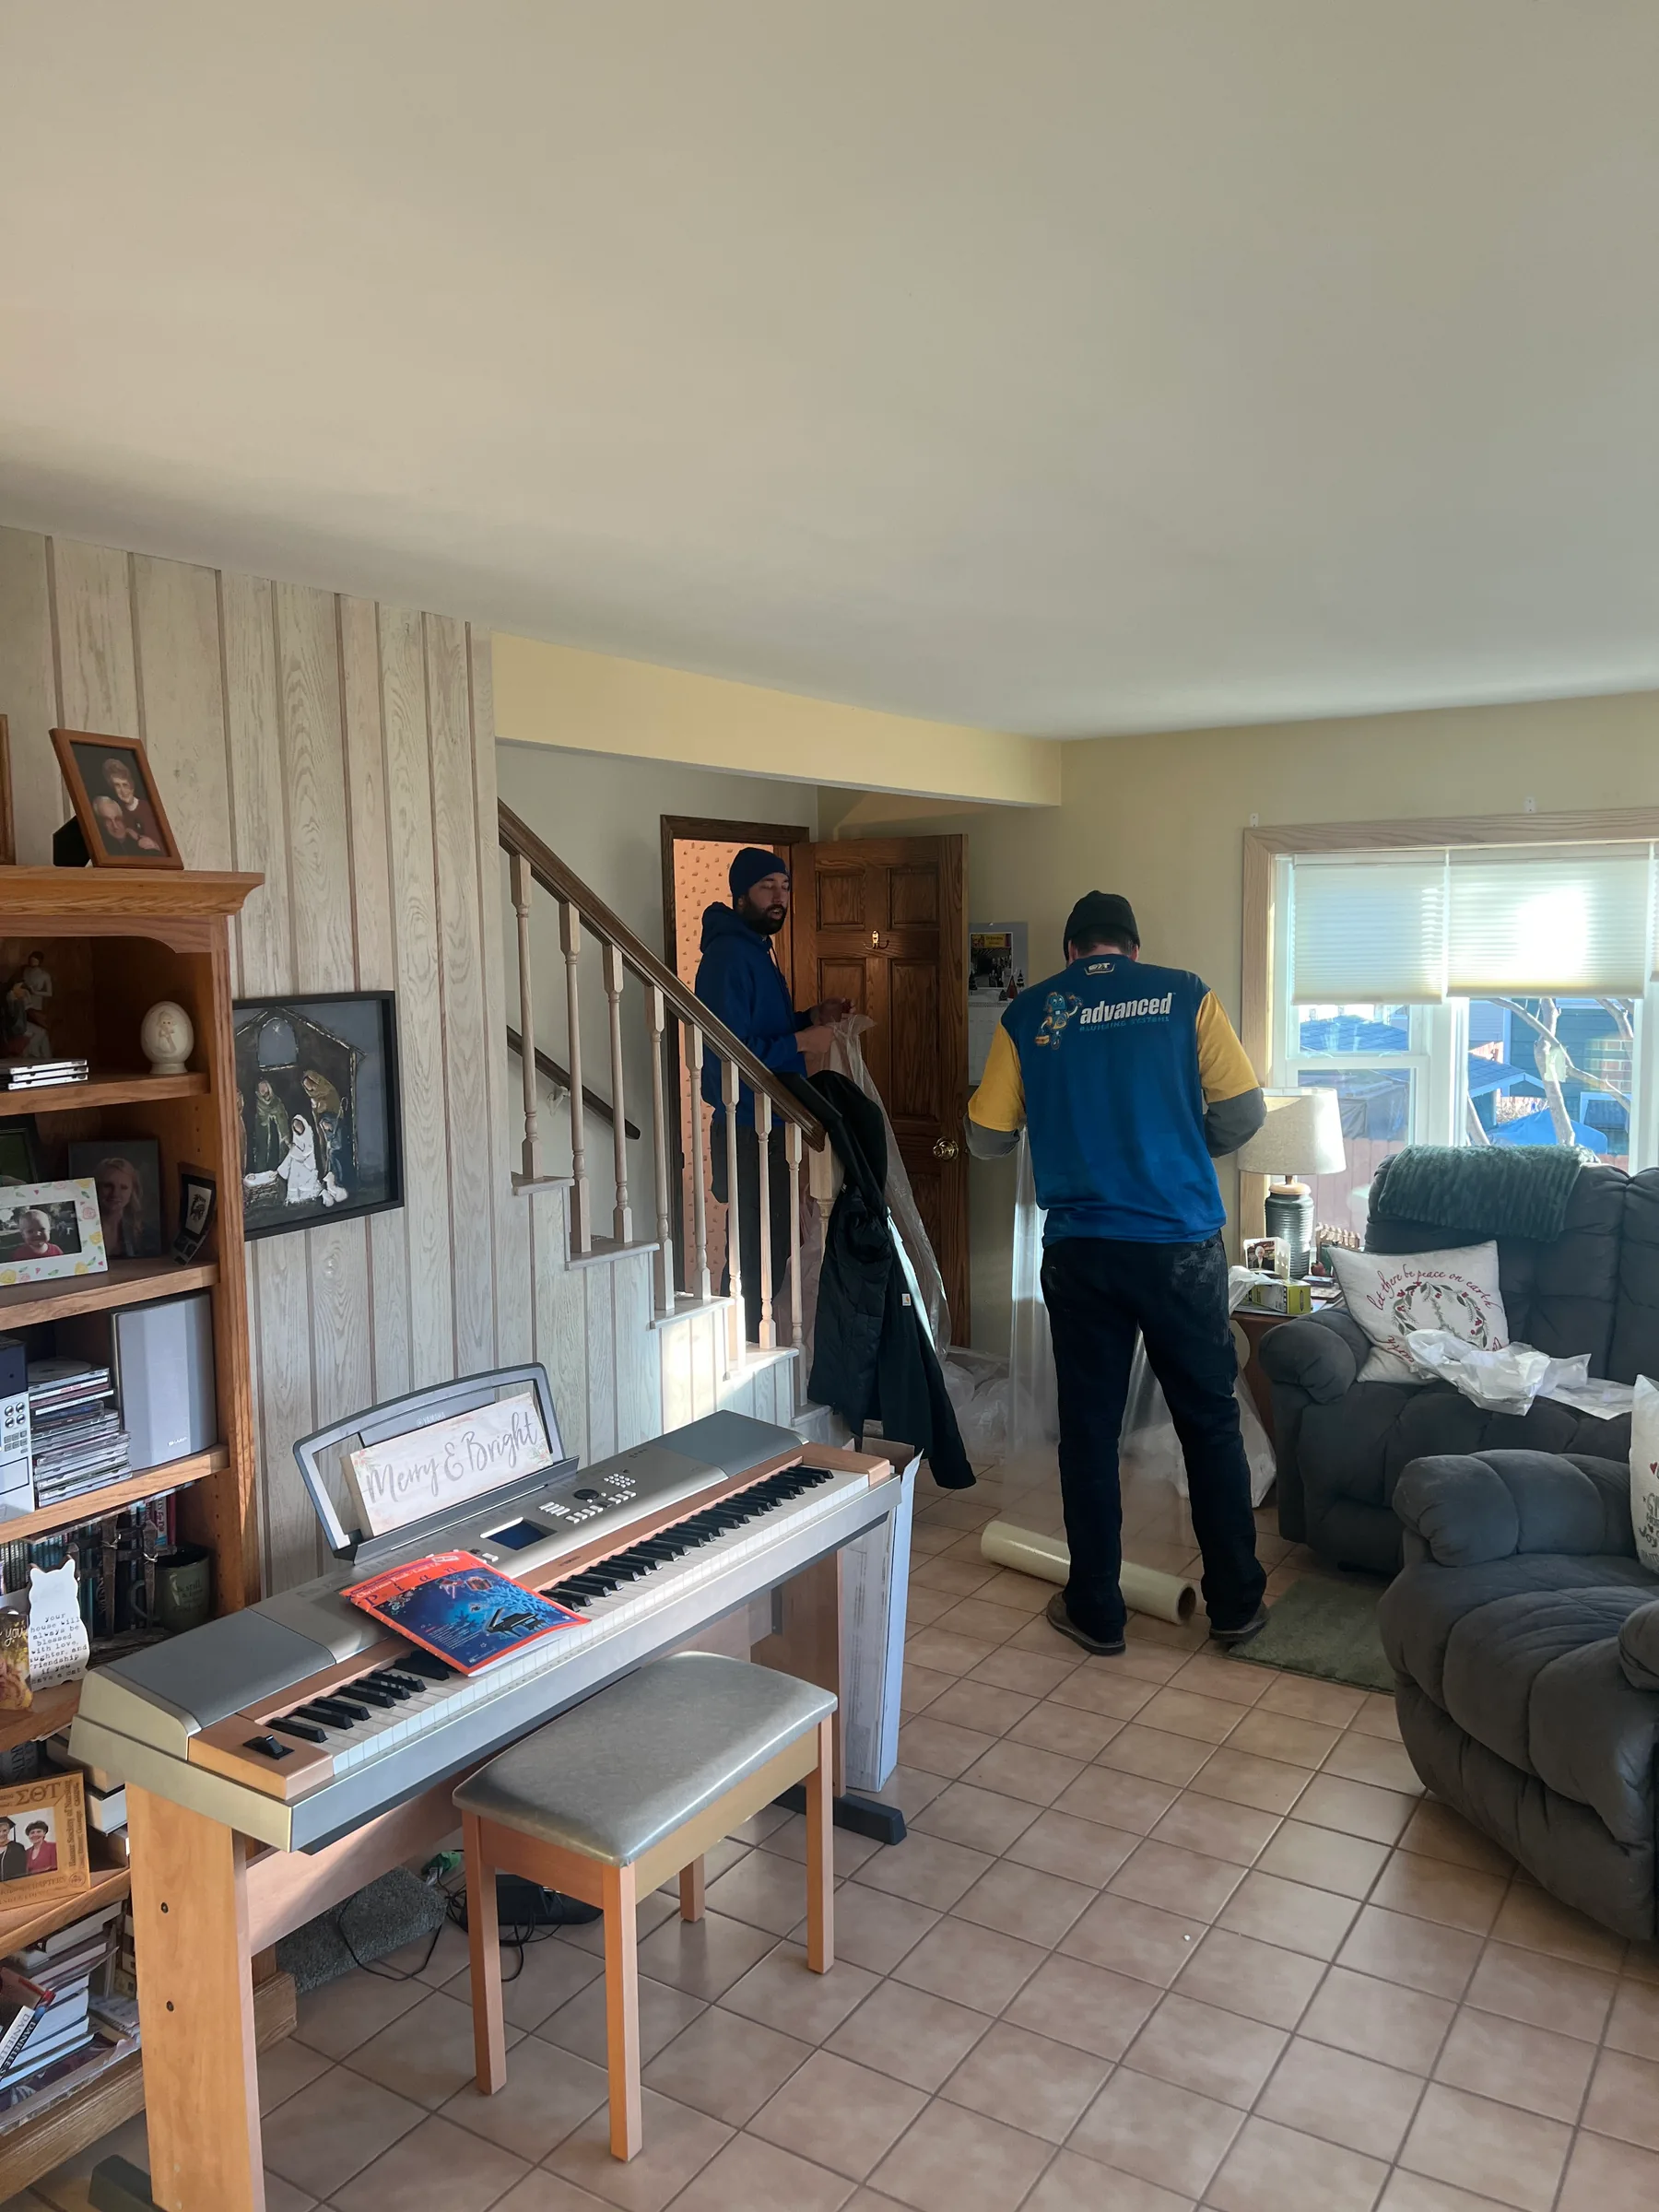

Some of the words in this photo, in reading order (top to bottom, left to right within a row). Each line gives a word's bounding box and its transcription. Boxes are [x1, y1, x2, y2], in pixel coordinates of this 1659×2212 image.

[1079, 993, 1172, 1025] advanced
[1402, 1264, 1416, 1278] be
[1449, 1273, 1465, 1283] on
[422, 1411, 447, 1426] YAMAHA
[366, 1456, 440, 1504] Merry
[461, 1411, 537, 1471] Bright
[30, 1623, 56, 1633] house
[61, 1617, 80, 1626] will
[44, 1613, 66, 1623] your
[32, 1629, 65, 1641] always
[37, 1633, 72, 1647] blessed
[31, 1645, 52, 1654] with
[71, 1643, 88, 1653] and
[55, 1664, 71, 1673] you
